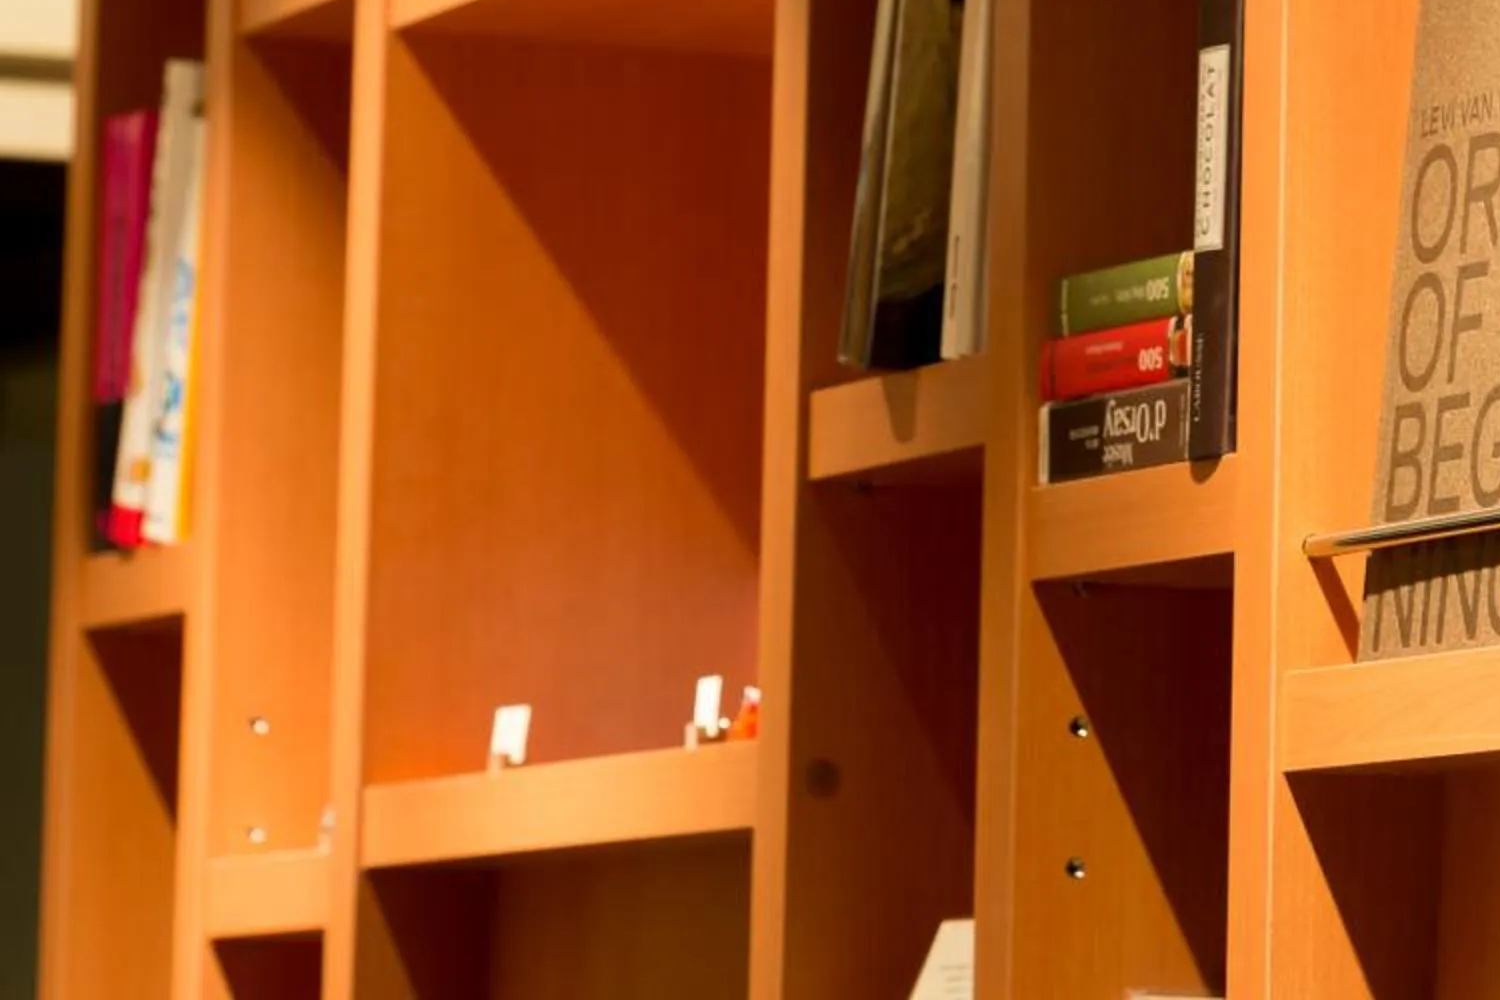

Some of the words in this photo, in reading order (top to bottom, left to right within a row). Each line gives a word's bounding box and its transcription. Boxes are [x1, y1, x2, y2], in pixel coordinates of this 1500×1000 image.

[1420, 105, 1455, 138] LEVI
[1461, 90, 1494, 127] VAN
[1199, 65, 1216, 236] CHOCOLAT
[1146, 276, 1170, 302] 500
[1399, 260, 1489, 393] OF
[1138, 346, 1163, 372] 500
